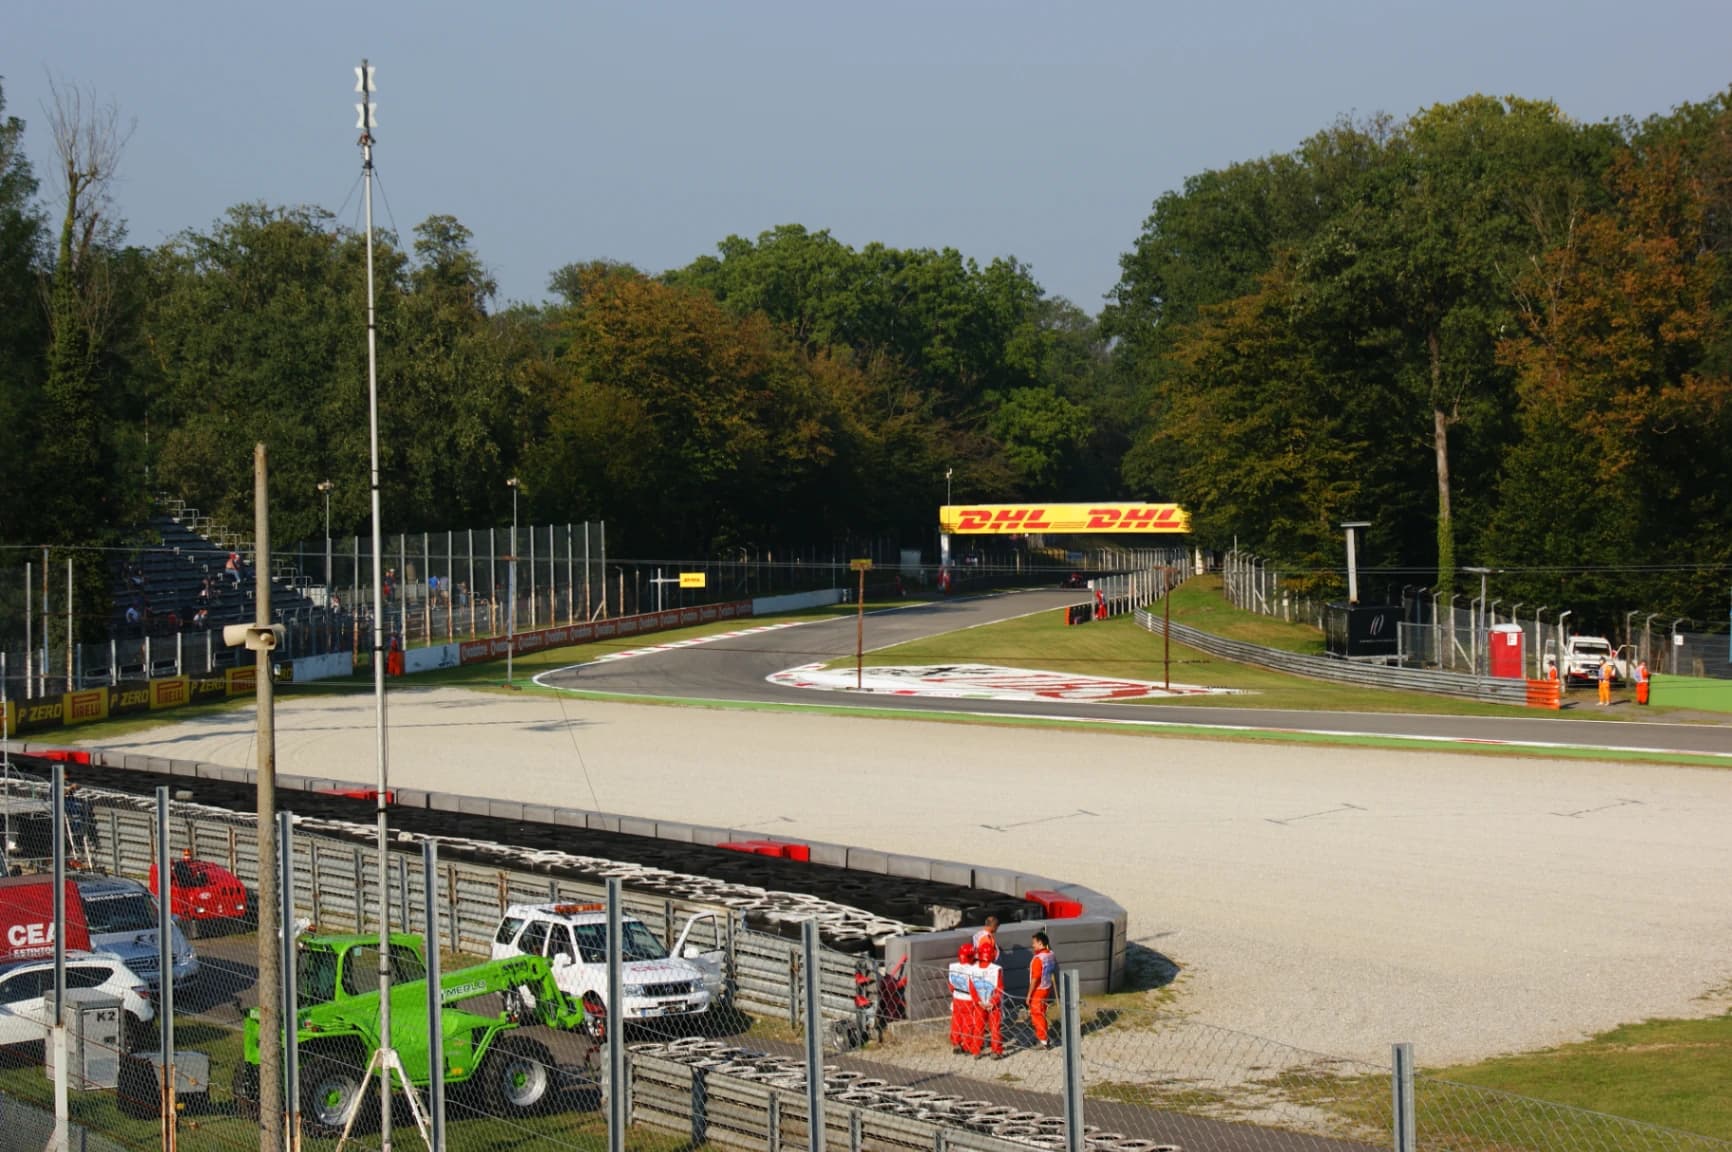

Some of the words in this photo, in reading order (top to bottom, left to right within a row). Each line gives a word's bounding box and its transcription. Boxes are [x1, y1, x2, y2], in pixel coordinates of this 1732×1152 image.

[958, 509, 1051, 530] DHL
[1086, 508, 1182, 529] DHL
[119, 689, 149, 706] ZERO
[17, 707, 25, 724] P
[28, 703, 62, 722] ZERO
[97, 1011, 115, 1022] K2
